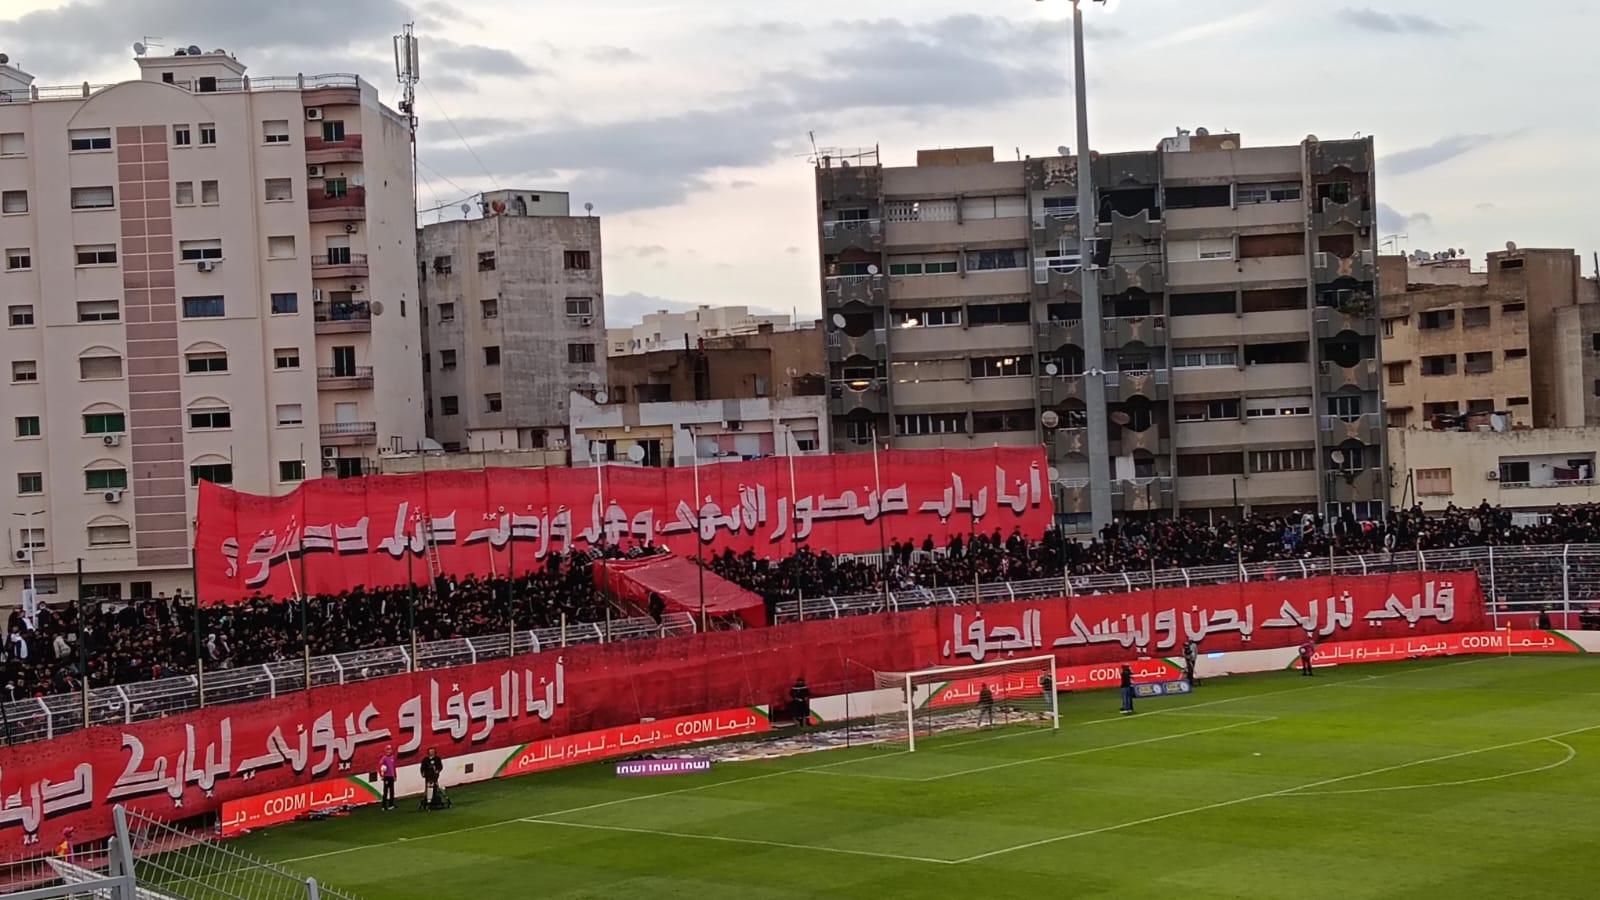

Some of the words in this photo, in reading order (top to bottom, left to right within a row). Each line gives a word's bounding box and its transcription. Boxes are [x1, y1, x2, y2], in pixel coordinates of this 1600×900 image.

[919, 472, 987, 524] باب
[996, 459, 1041, 511] أنا
[1363, 581, 1455, 628] قلبي
[1182, 603, 1254, 642] يحن
[1461, 636, 1503, 648] CODM
[525, 655, 564, 719] أنا
[430, 670, 519, 740] الوفا
[675, 718, 713, 737] CODM
[716, 713, 757, 730] ديما
[620, 730, 661, 745] ديما
[263, 793, 306, 817] CODM
[310, 786, 356, 807] ديما
